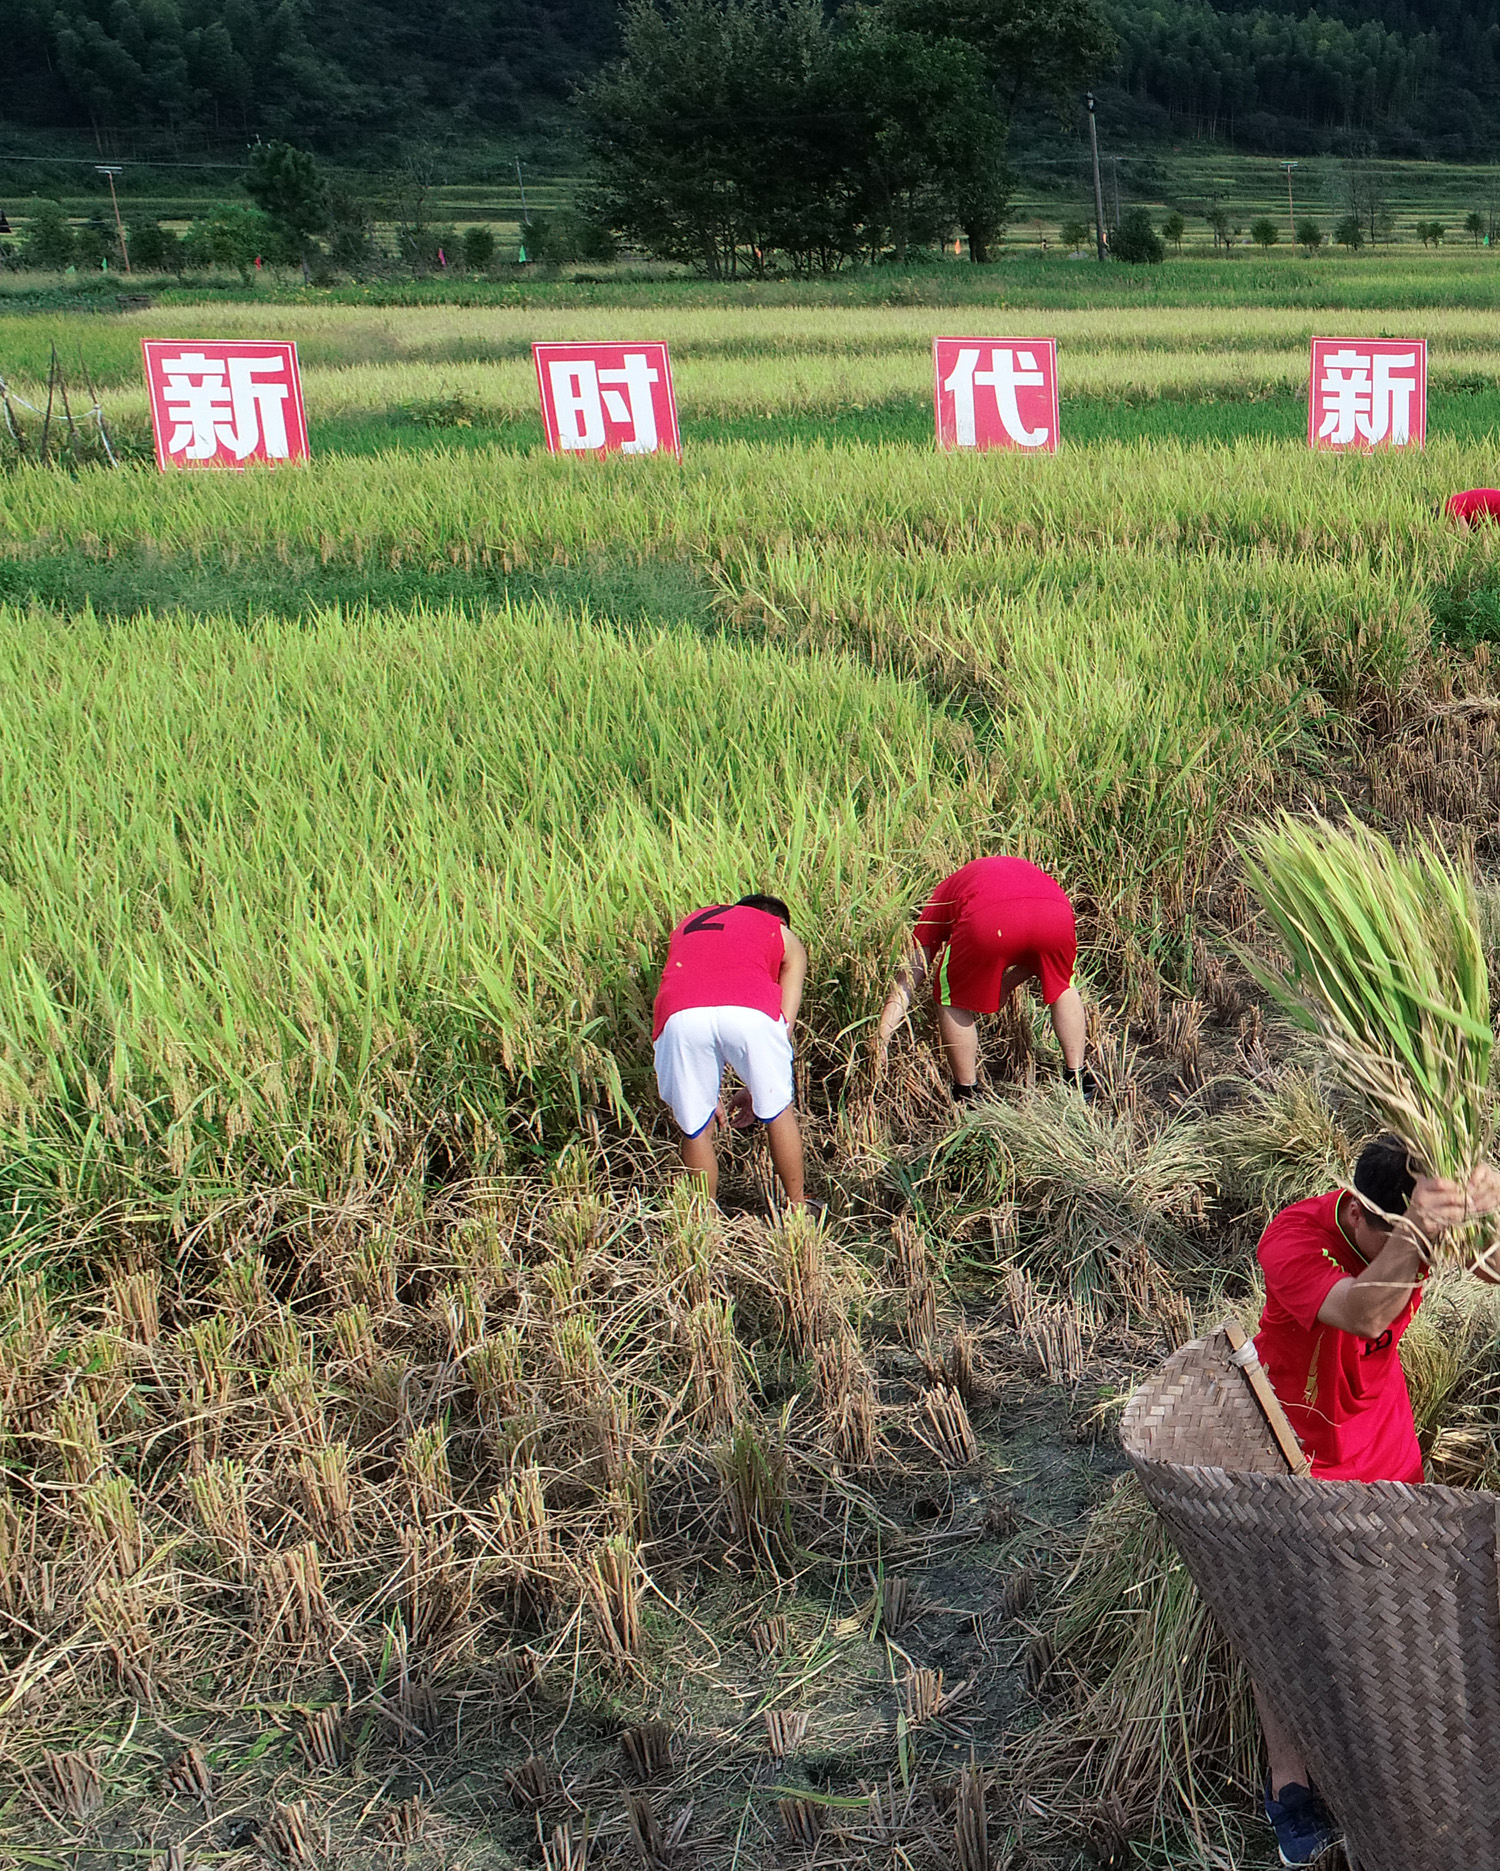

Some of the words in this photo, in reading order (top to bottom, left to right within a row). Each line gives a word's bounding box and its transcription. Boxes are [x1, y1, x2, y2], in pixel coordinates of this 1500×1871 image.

[162, 353, 289, 460] 新
[549, 354, 659, 455] 时
[944, 349, 1049, 448] 代
[1318, 350, 1416, 447] 新
[683, 905, 735, 935] 2
